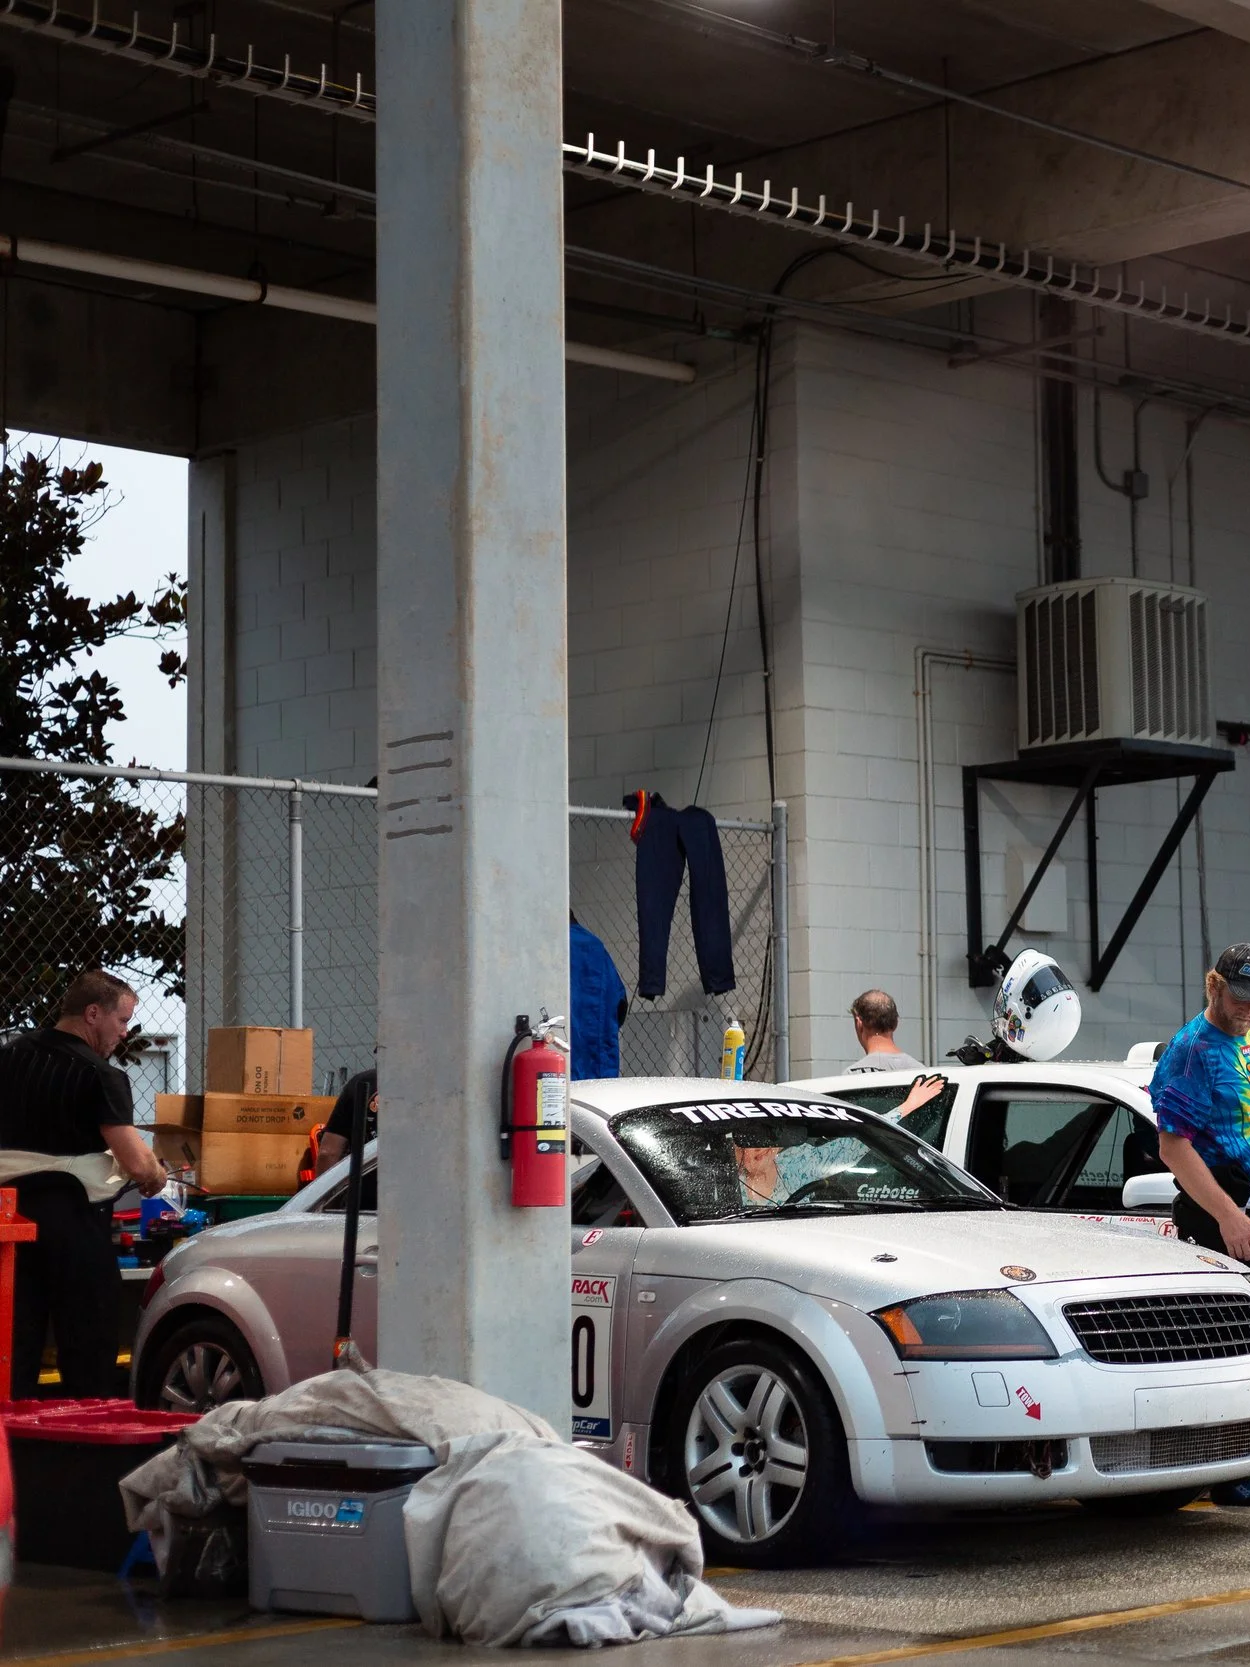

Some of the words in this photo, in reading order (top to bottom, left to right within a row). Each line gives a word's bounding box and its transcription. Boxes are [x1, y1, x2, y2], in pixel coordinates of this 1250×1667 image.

[236, 1115, 248, 1123] DO
[248, 1115, 264, 1123] NOT
[265, 1115, 286, 1124] DROP
[670, 1102, 768, 1124] TIRE
[758, 1102, 864, 1123] RACK
[583, 1230, 602, 1244] E
[572, 1279, 609, 1303] RACK
[572, 1315, 595, 1409] 0
[1018, 1388, 1034, 1408] TOW
[572, 1419, 598, 1433] pCar
[287, 1500, 336, 1519] IGLOO
